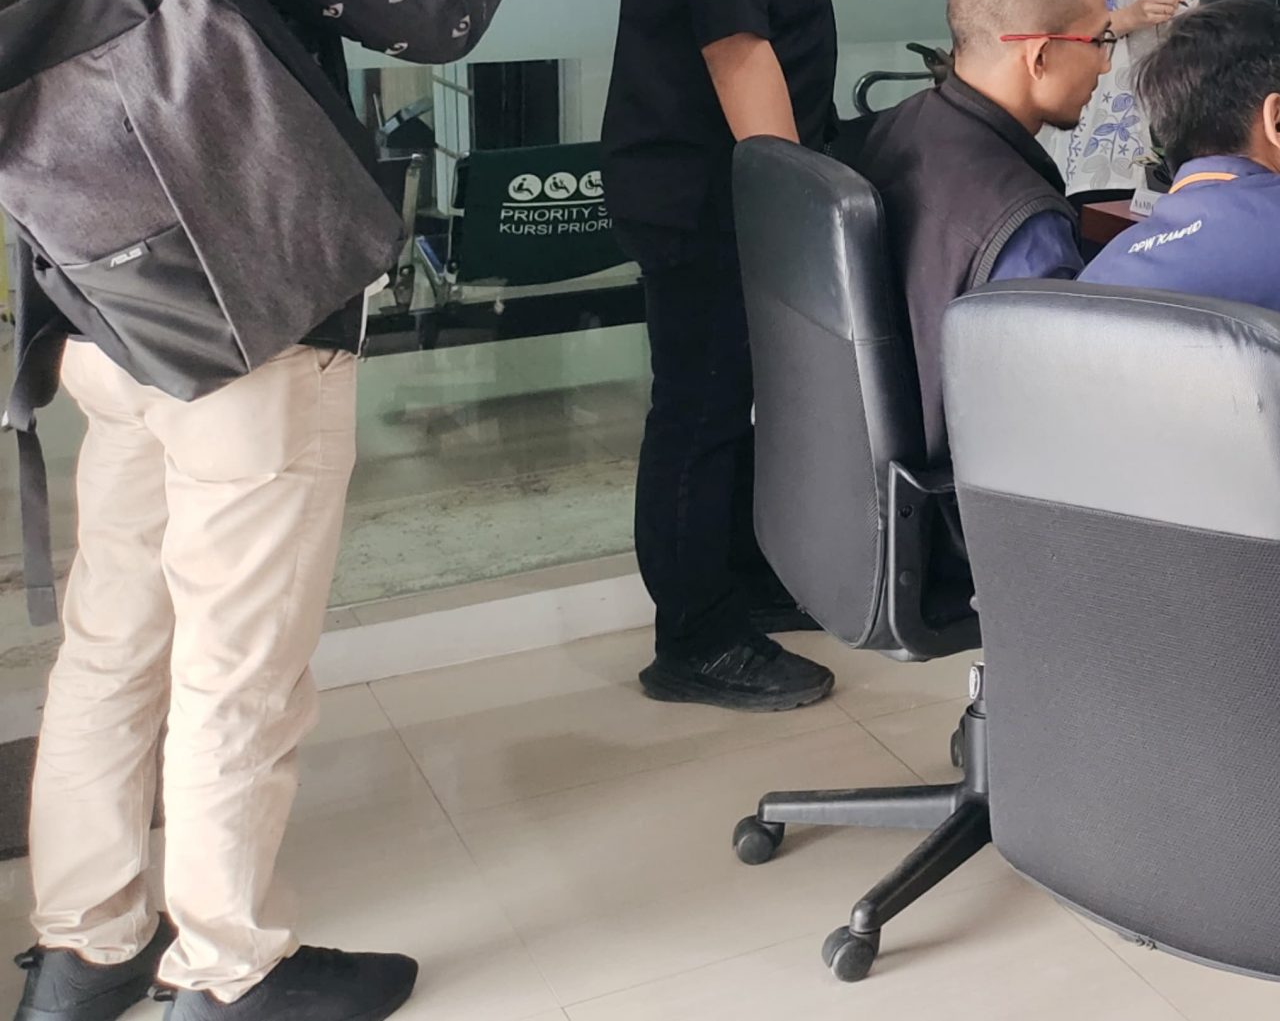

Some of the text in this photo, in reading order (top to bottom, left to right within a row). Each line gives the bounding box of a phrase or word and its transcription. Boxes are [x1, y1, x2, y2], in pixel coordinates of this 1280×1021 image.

[500, 205, 609, 222] PRIORITY S
[499, 218, 612, 235] KURSI PRIORI
[110, 247, 142, 268] ASUS
